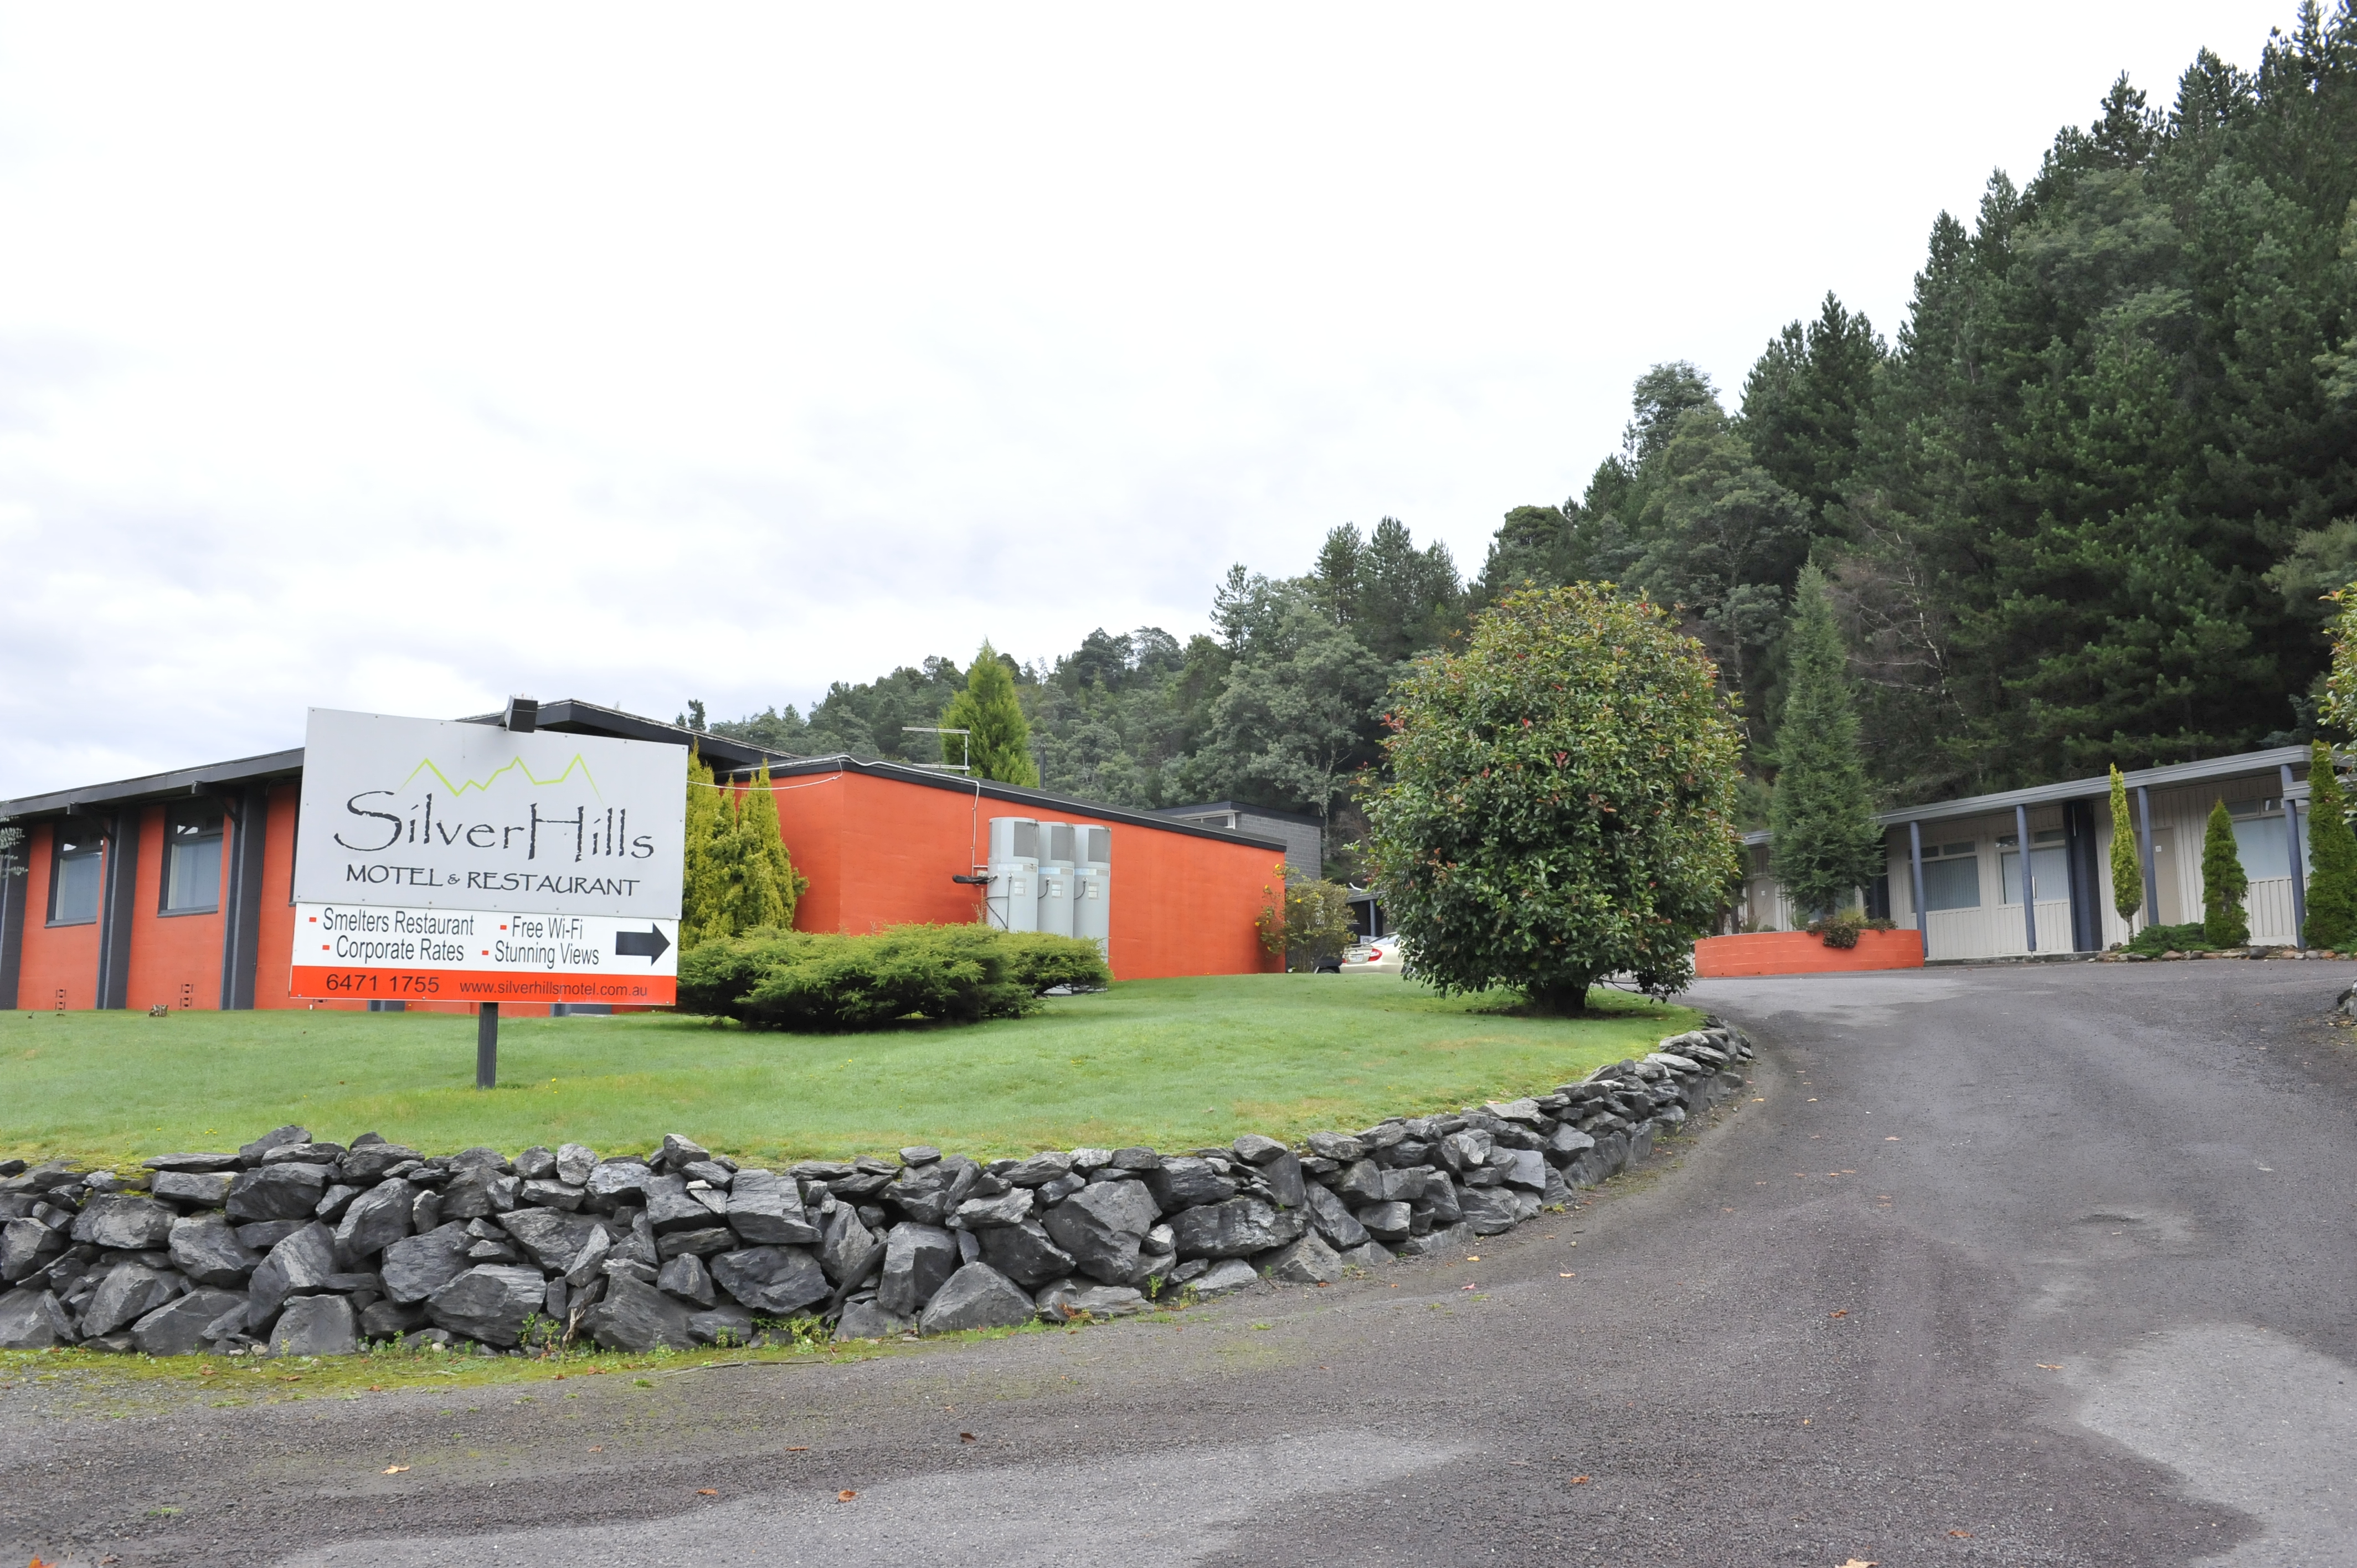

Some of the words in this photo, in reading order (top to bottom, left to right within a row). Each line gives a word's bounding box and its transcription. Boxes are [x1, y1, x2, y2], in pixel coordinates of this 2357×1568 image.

[346, 864, 443, 886] MOTEL
[447, 874, 460, 885] &
[467, 871, 641, 896] RESTAURANT
[323, 907, 389, 932] Smelters
[394, 910, 474, 936] Restaurant
[512, 916, 543, 938] Free
[548, 917, 583, 940] Wi-Fi
[337, 935, 414, 964] Corporate
[420, 938, 464, 961] Rates
[495, 940, 555, 969] Stunning
[560, 943, 600, 965] Views
[326, 974, 378, 992] 6471
[389, 976, 440, 993] 1755
[460, 980, 647, 997] www.silverhillsmotel.com.au
